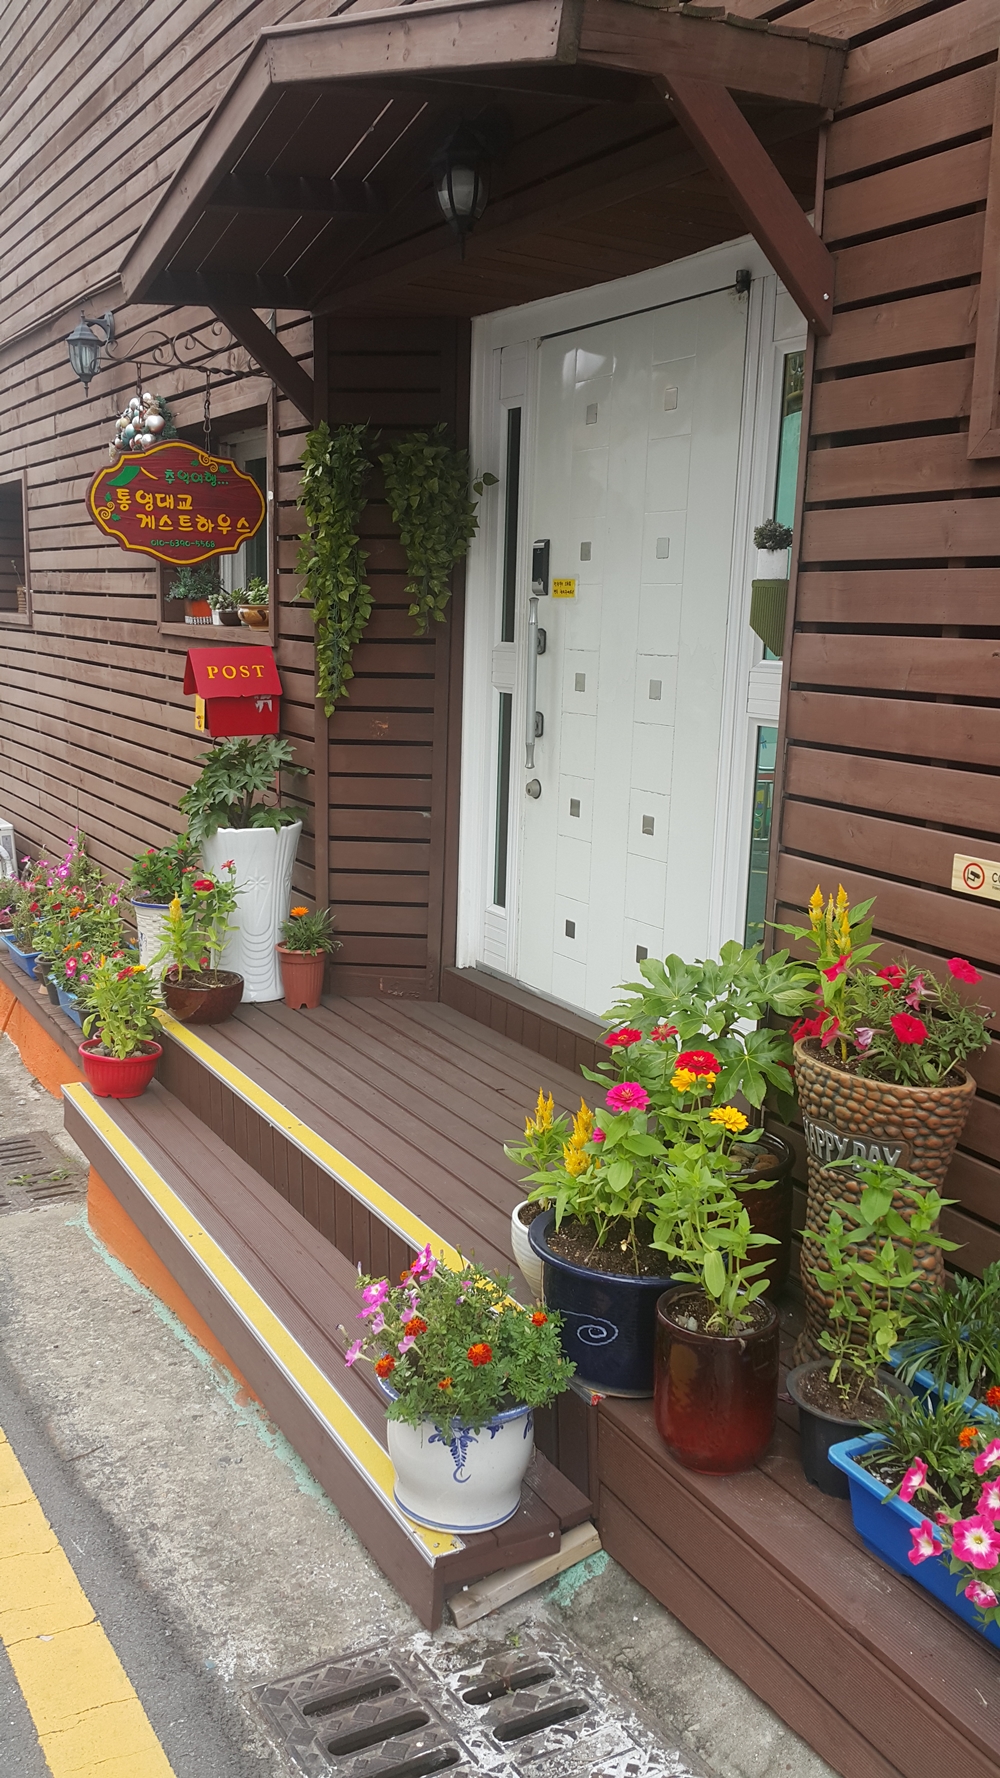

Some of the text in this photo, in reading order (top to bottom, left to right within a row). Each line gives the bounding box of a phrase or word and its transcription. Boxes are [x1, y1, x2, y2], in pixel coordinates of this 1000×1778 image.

[115, 488, 193, 511] 통영대교
[135, 513, 251, 535] 게스트하우스
[150, 539, 216, 548] 010-6390-5568
[206, 665, 265, 679] POST
[851, 1140, 902, 1173] DAY
